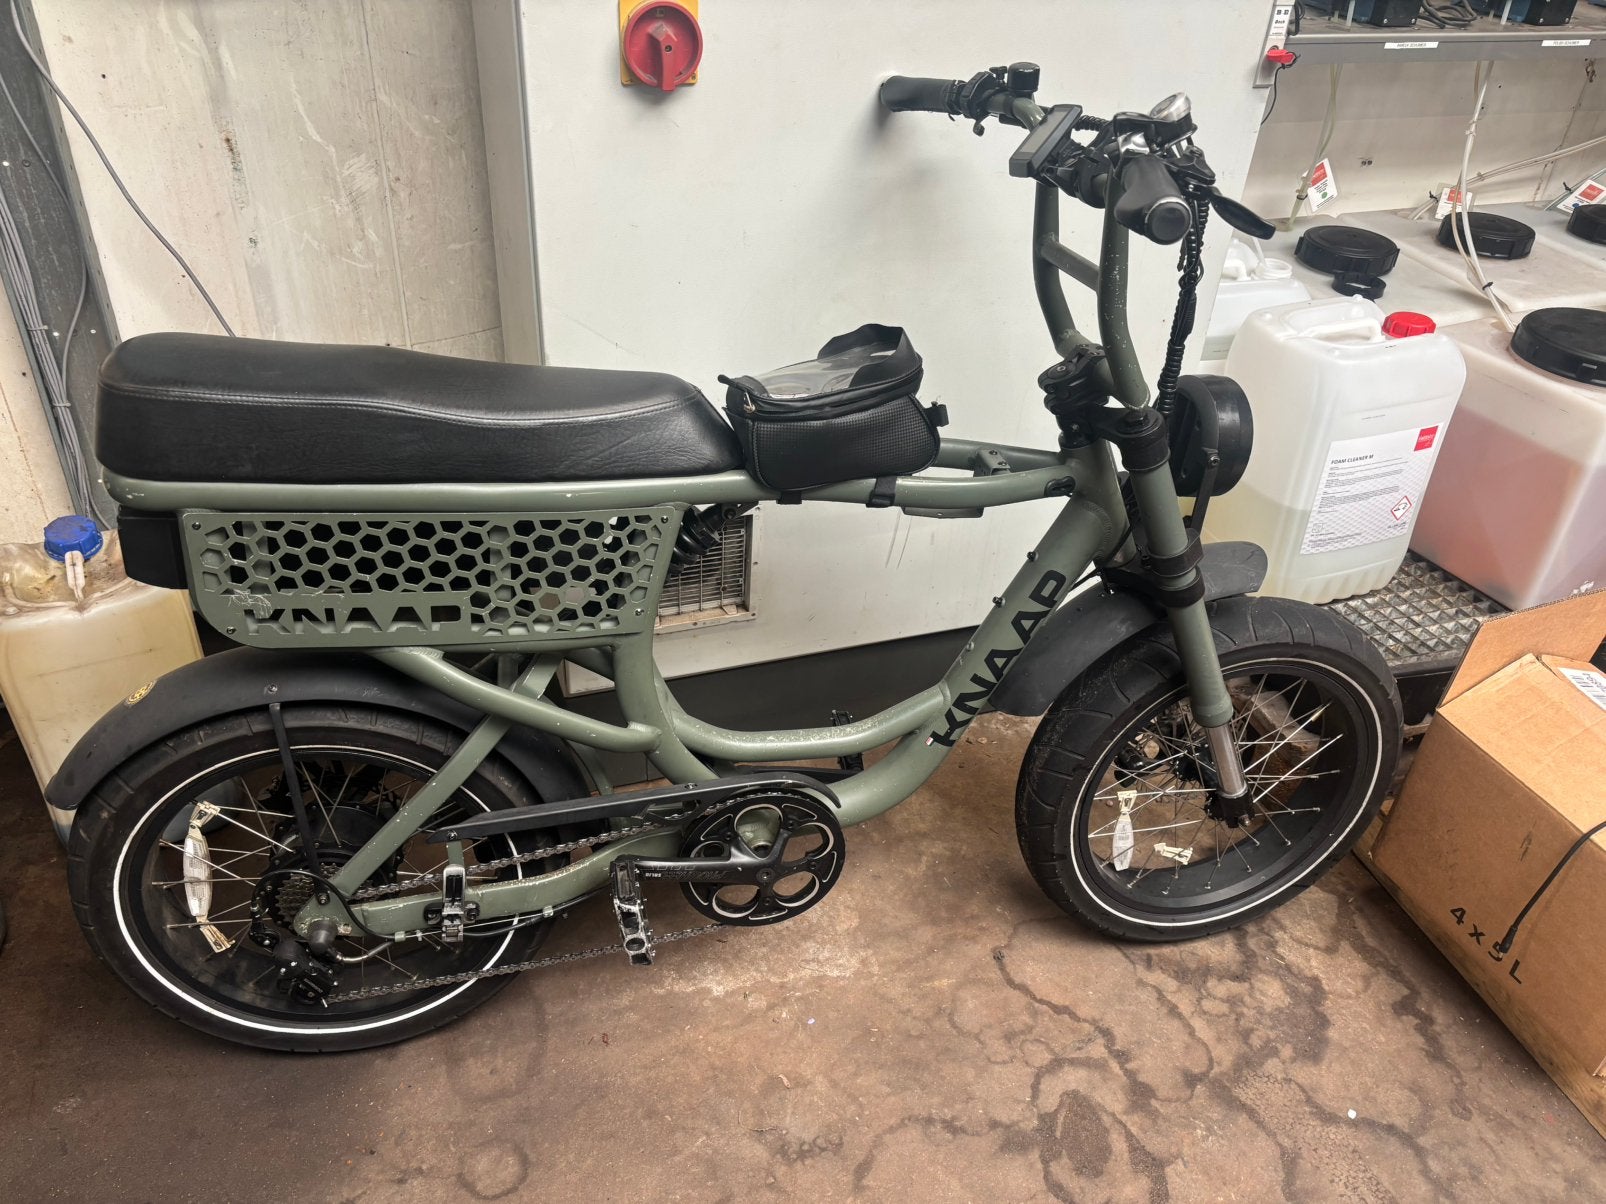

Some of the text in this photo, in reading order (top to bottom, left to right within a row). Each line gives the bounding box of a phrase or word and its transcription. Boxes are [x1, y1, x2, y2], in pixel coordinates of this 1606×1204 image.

[1347, 455, 1369, 463] CLEANER
[243, 604, 462, 636] KNAAP
[930, 569, 1067, 747] KNAAP
